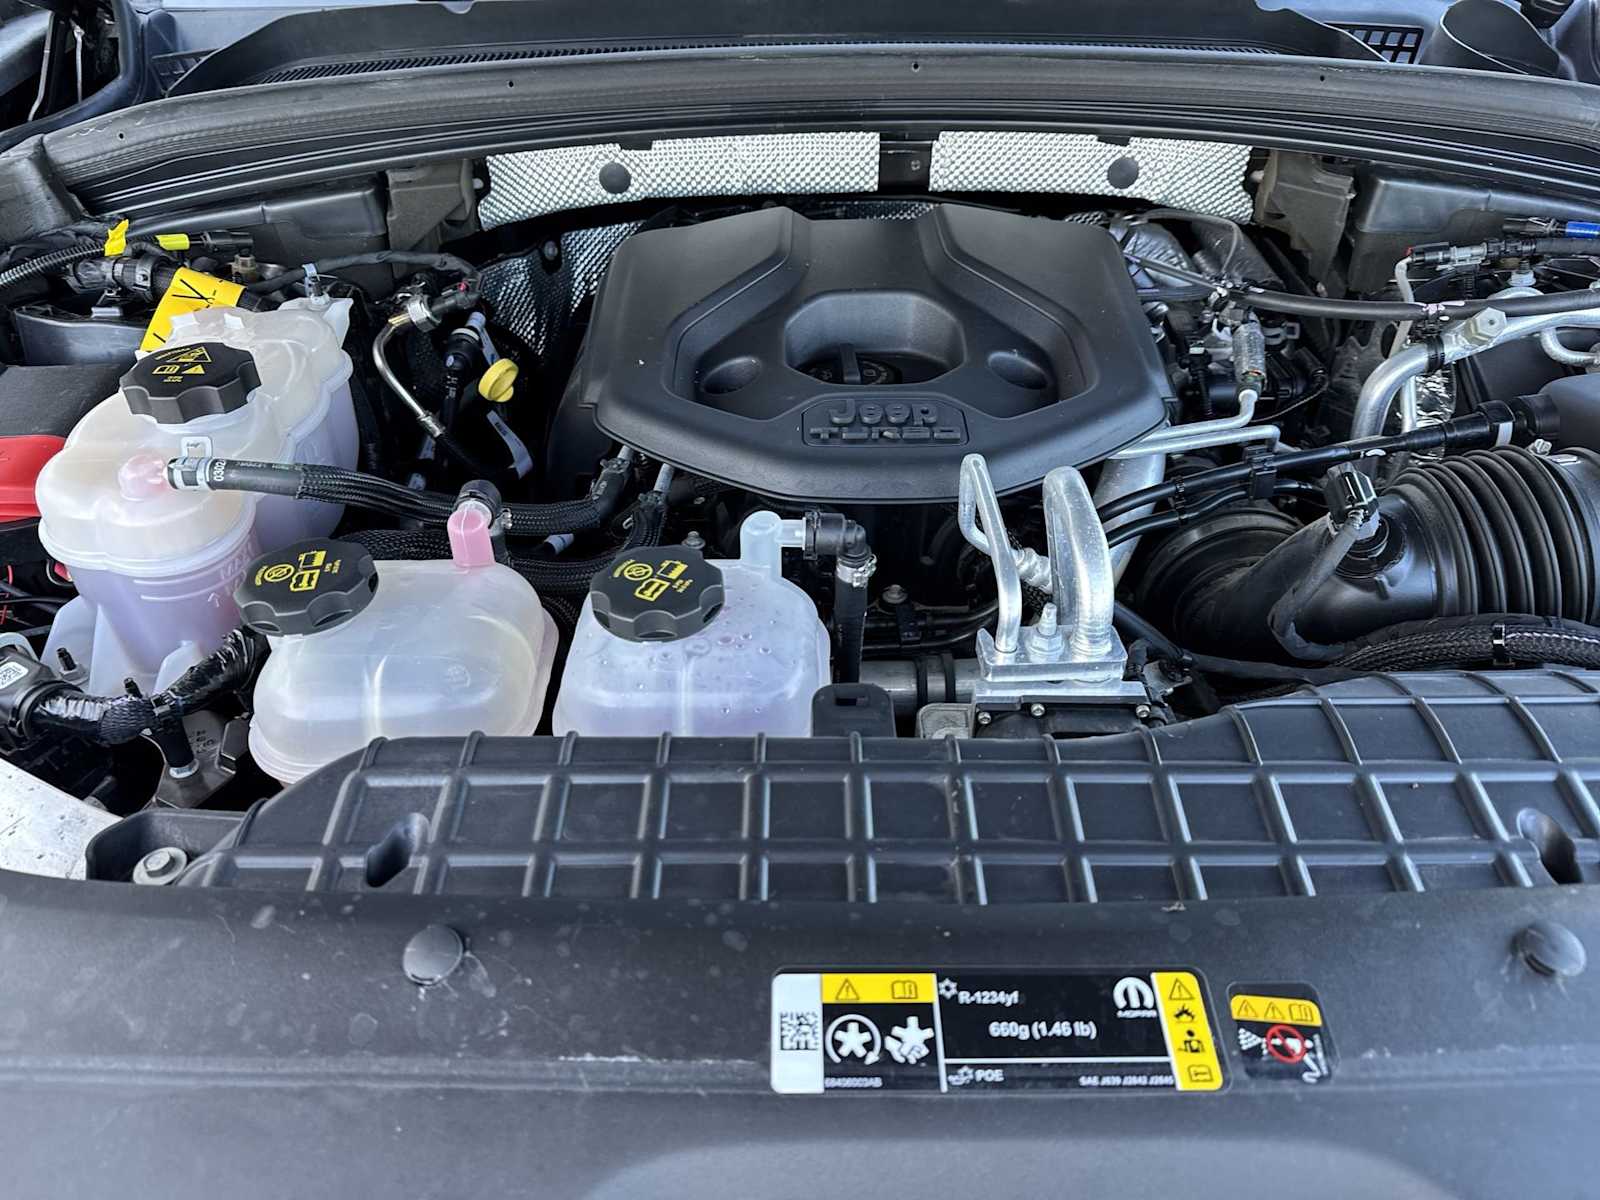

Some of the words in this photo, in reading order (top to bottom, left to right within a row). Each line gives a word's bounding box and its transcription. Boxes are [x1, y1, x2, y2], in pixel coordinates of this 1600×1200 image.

[988, 1021, 1030, 1040] 660g
[1031, 1020, 1072, 1040] (1.46
[1073, 1020, 1097, 1040] lb)
[974, 1069, 1005, 1082] POE
